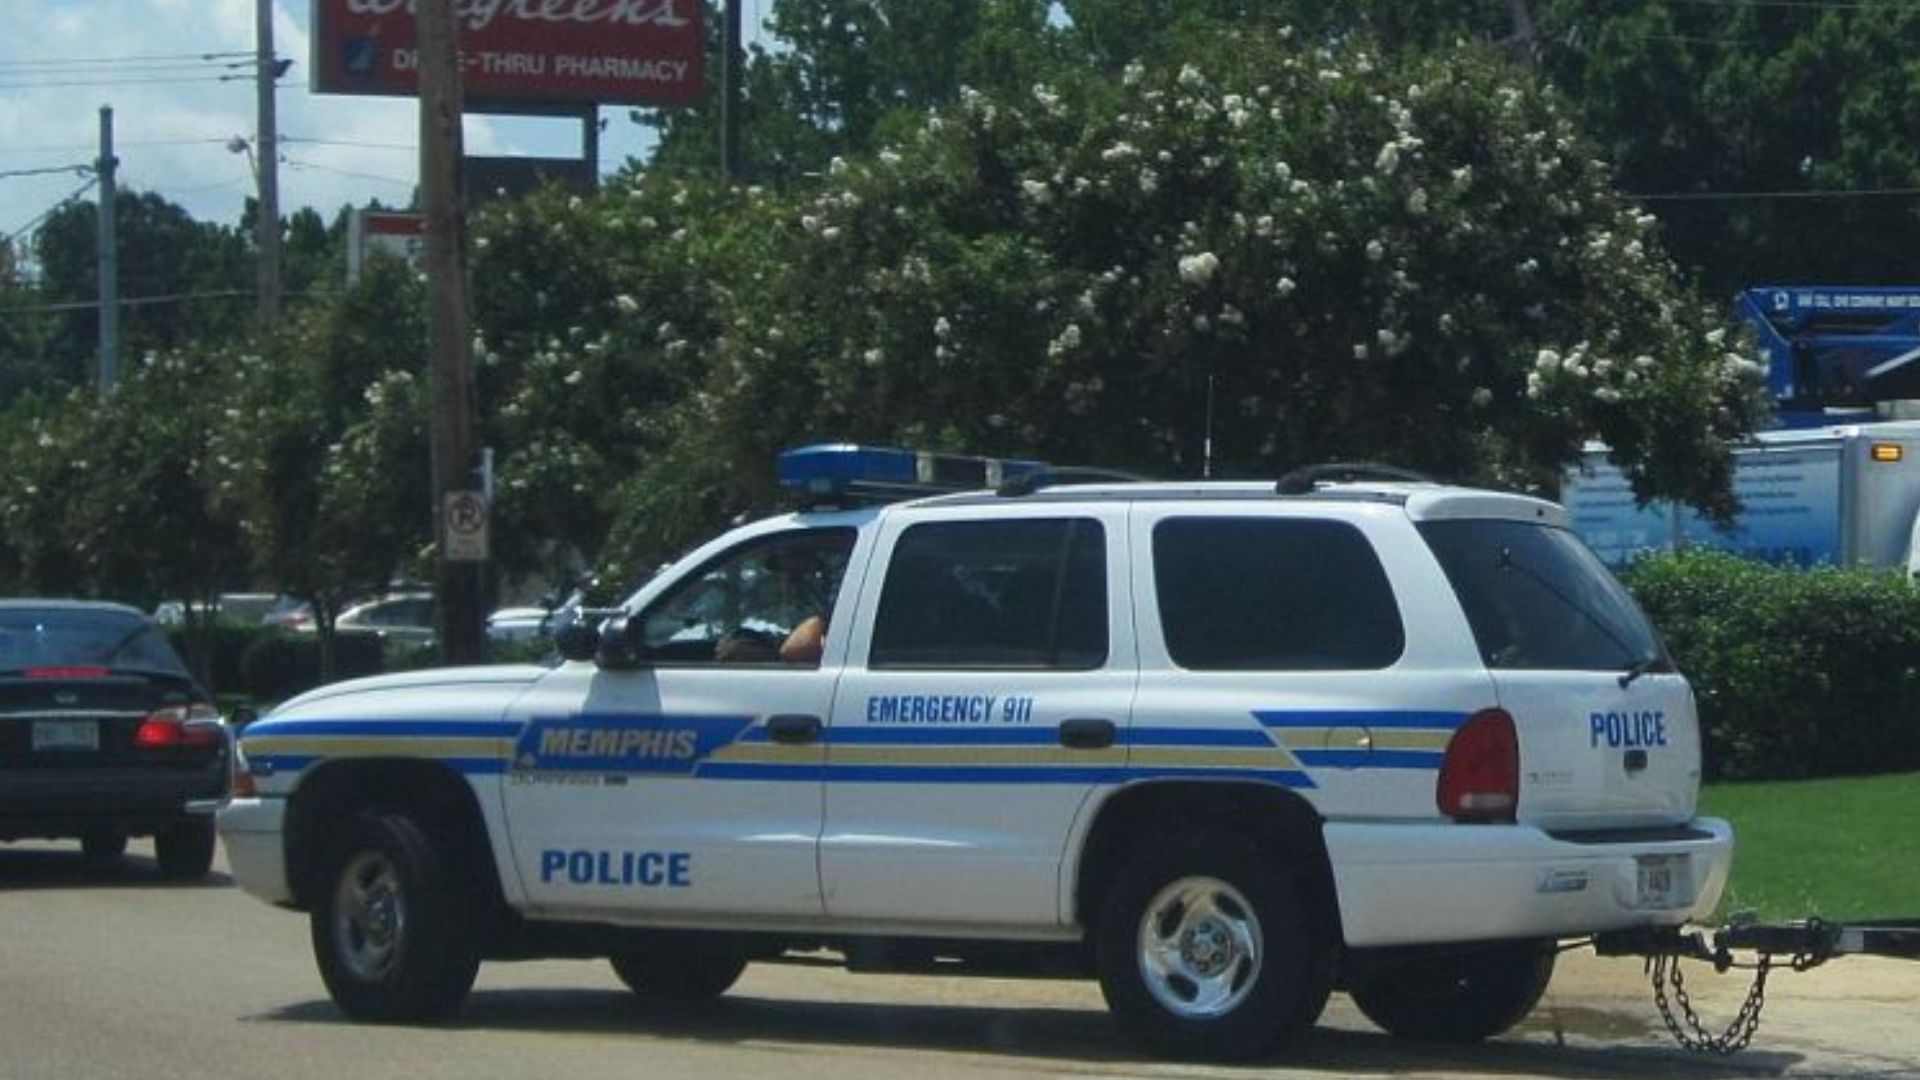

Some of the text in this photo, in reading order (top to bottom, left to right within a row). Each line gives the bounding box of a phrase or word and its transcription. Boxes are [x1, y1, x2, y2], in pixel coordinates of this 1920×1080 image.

[555, 56, 688, 81] PHARMACY
[867, 695, 1033, 723] EMERGENCY 911
[540, 727, 698, 761] MEMPHIS
[1590, 711, 1667, 748] POLICE
[541, 849, 692, 887] POLICE
